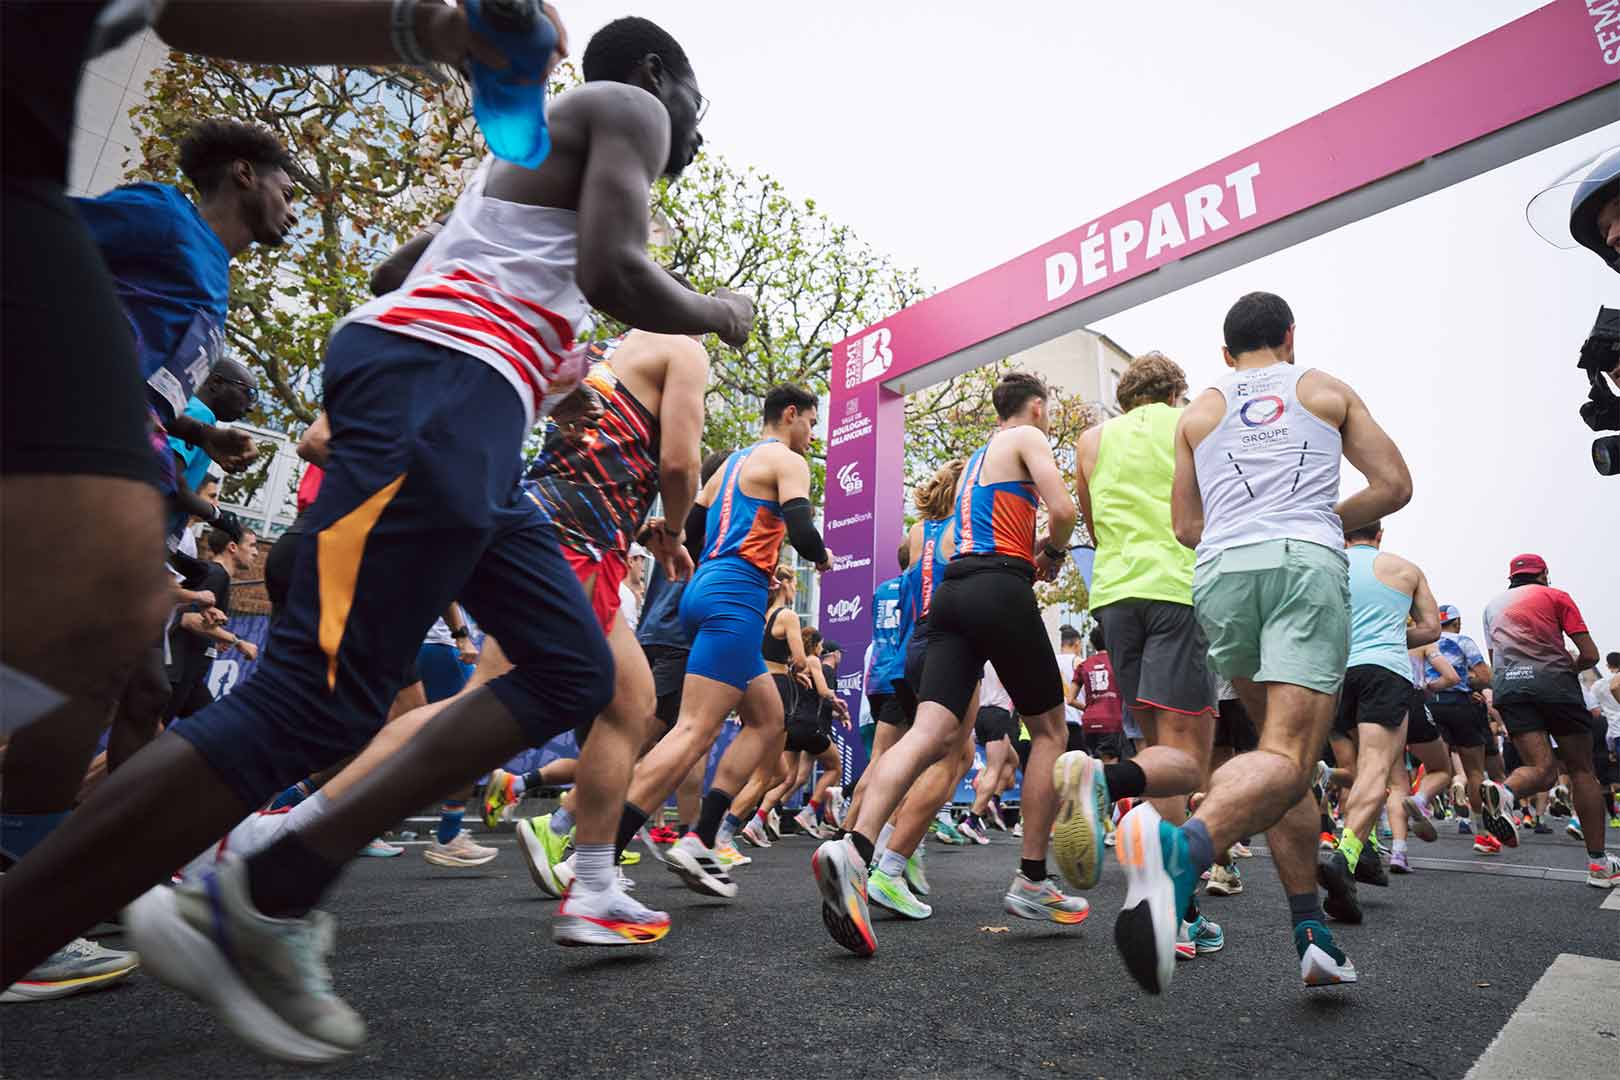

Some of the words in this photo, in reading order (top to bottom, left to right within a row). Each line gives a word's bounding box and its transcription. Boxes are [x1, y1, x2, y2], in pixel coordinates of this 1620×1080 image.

[1046, 162, 1261, 302] DÉPART
[846, 342, 857, 388] SEMI
[831, 425, 873, 447] BILLANCOURT
[832, 416, 871, 437] BOULOGNE-
[1241, 427, 1288, 444] GROUPE
